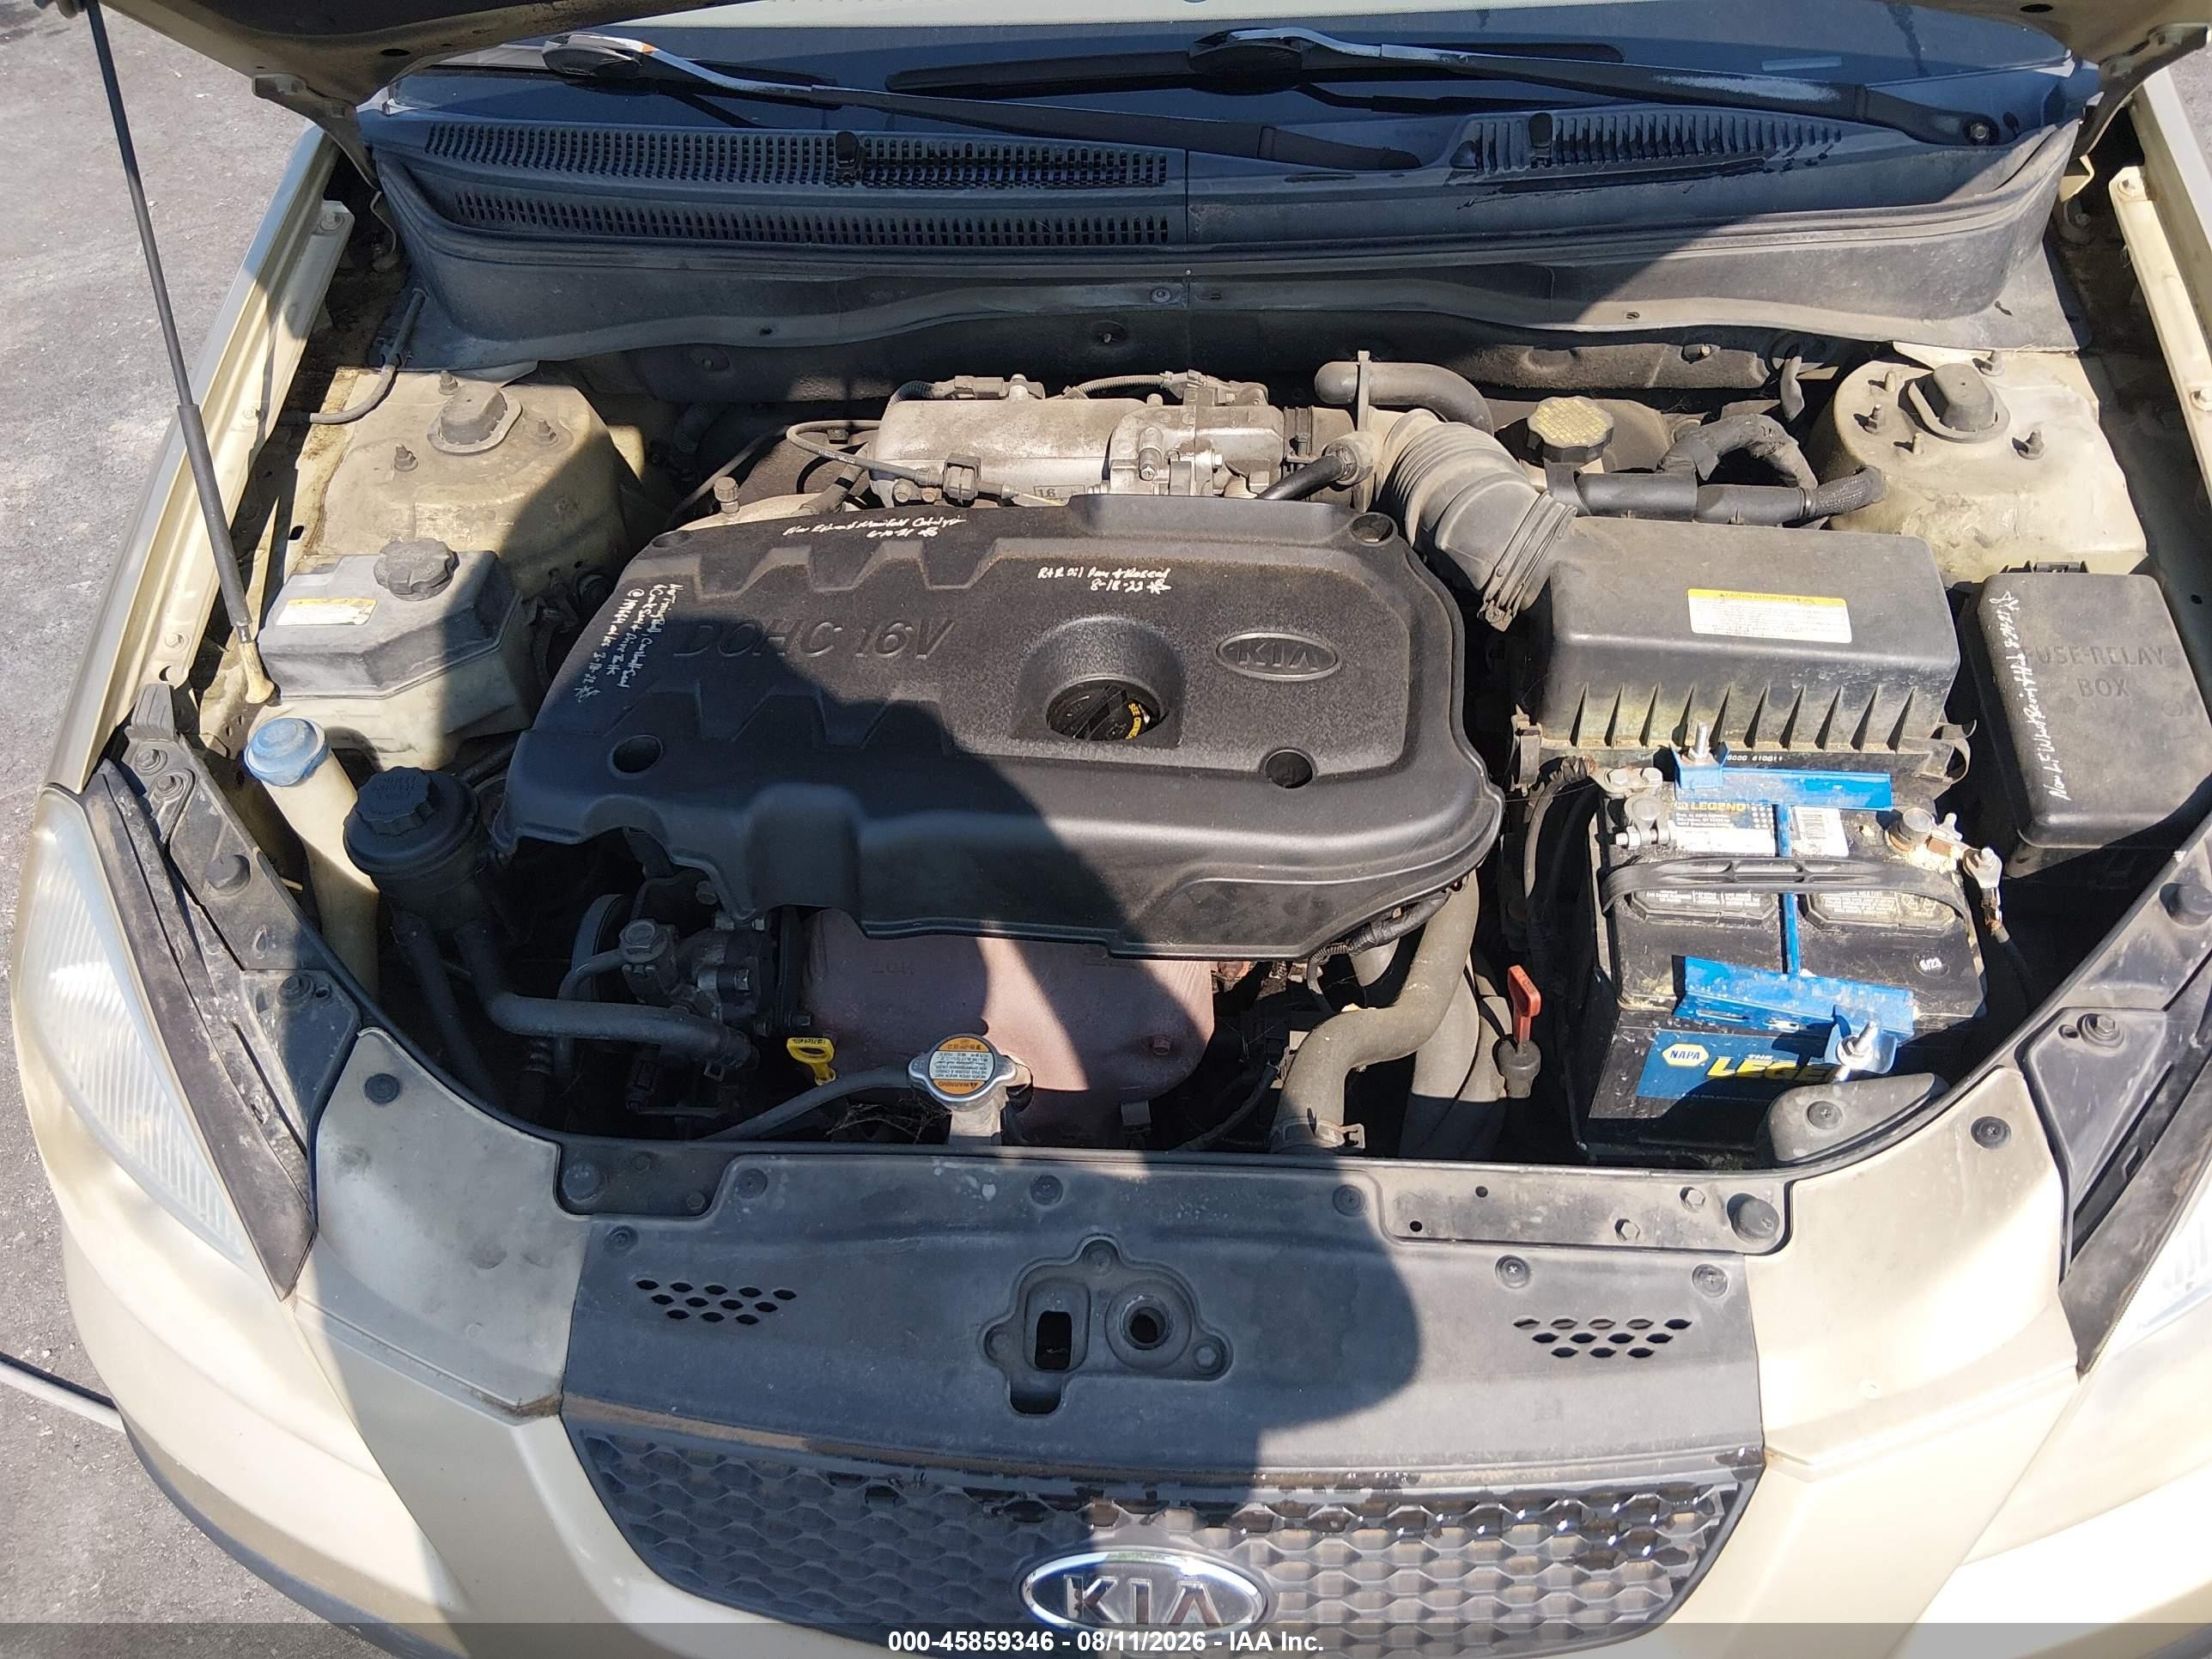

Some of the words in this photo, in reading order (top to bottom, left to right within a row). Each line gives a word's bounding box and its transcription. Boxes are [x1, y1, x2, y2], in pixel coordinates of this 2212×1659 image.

[672, 619, 843, 658] DOHC
[855, 617, 957, 659] 16V
[1237, 642, 1320, 672] KIA
[2077, 677, 2131, 697] BOX
[1127, 702, 1141, 717] SEE
[1690, 802, 1747, 812] LEGEND
[1669, 1048, 1702, 1061] NAPA
[1064, 1574, 1223, 1627] KIA
